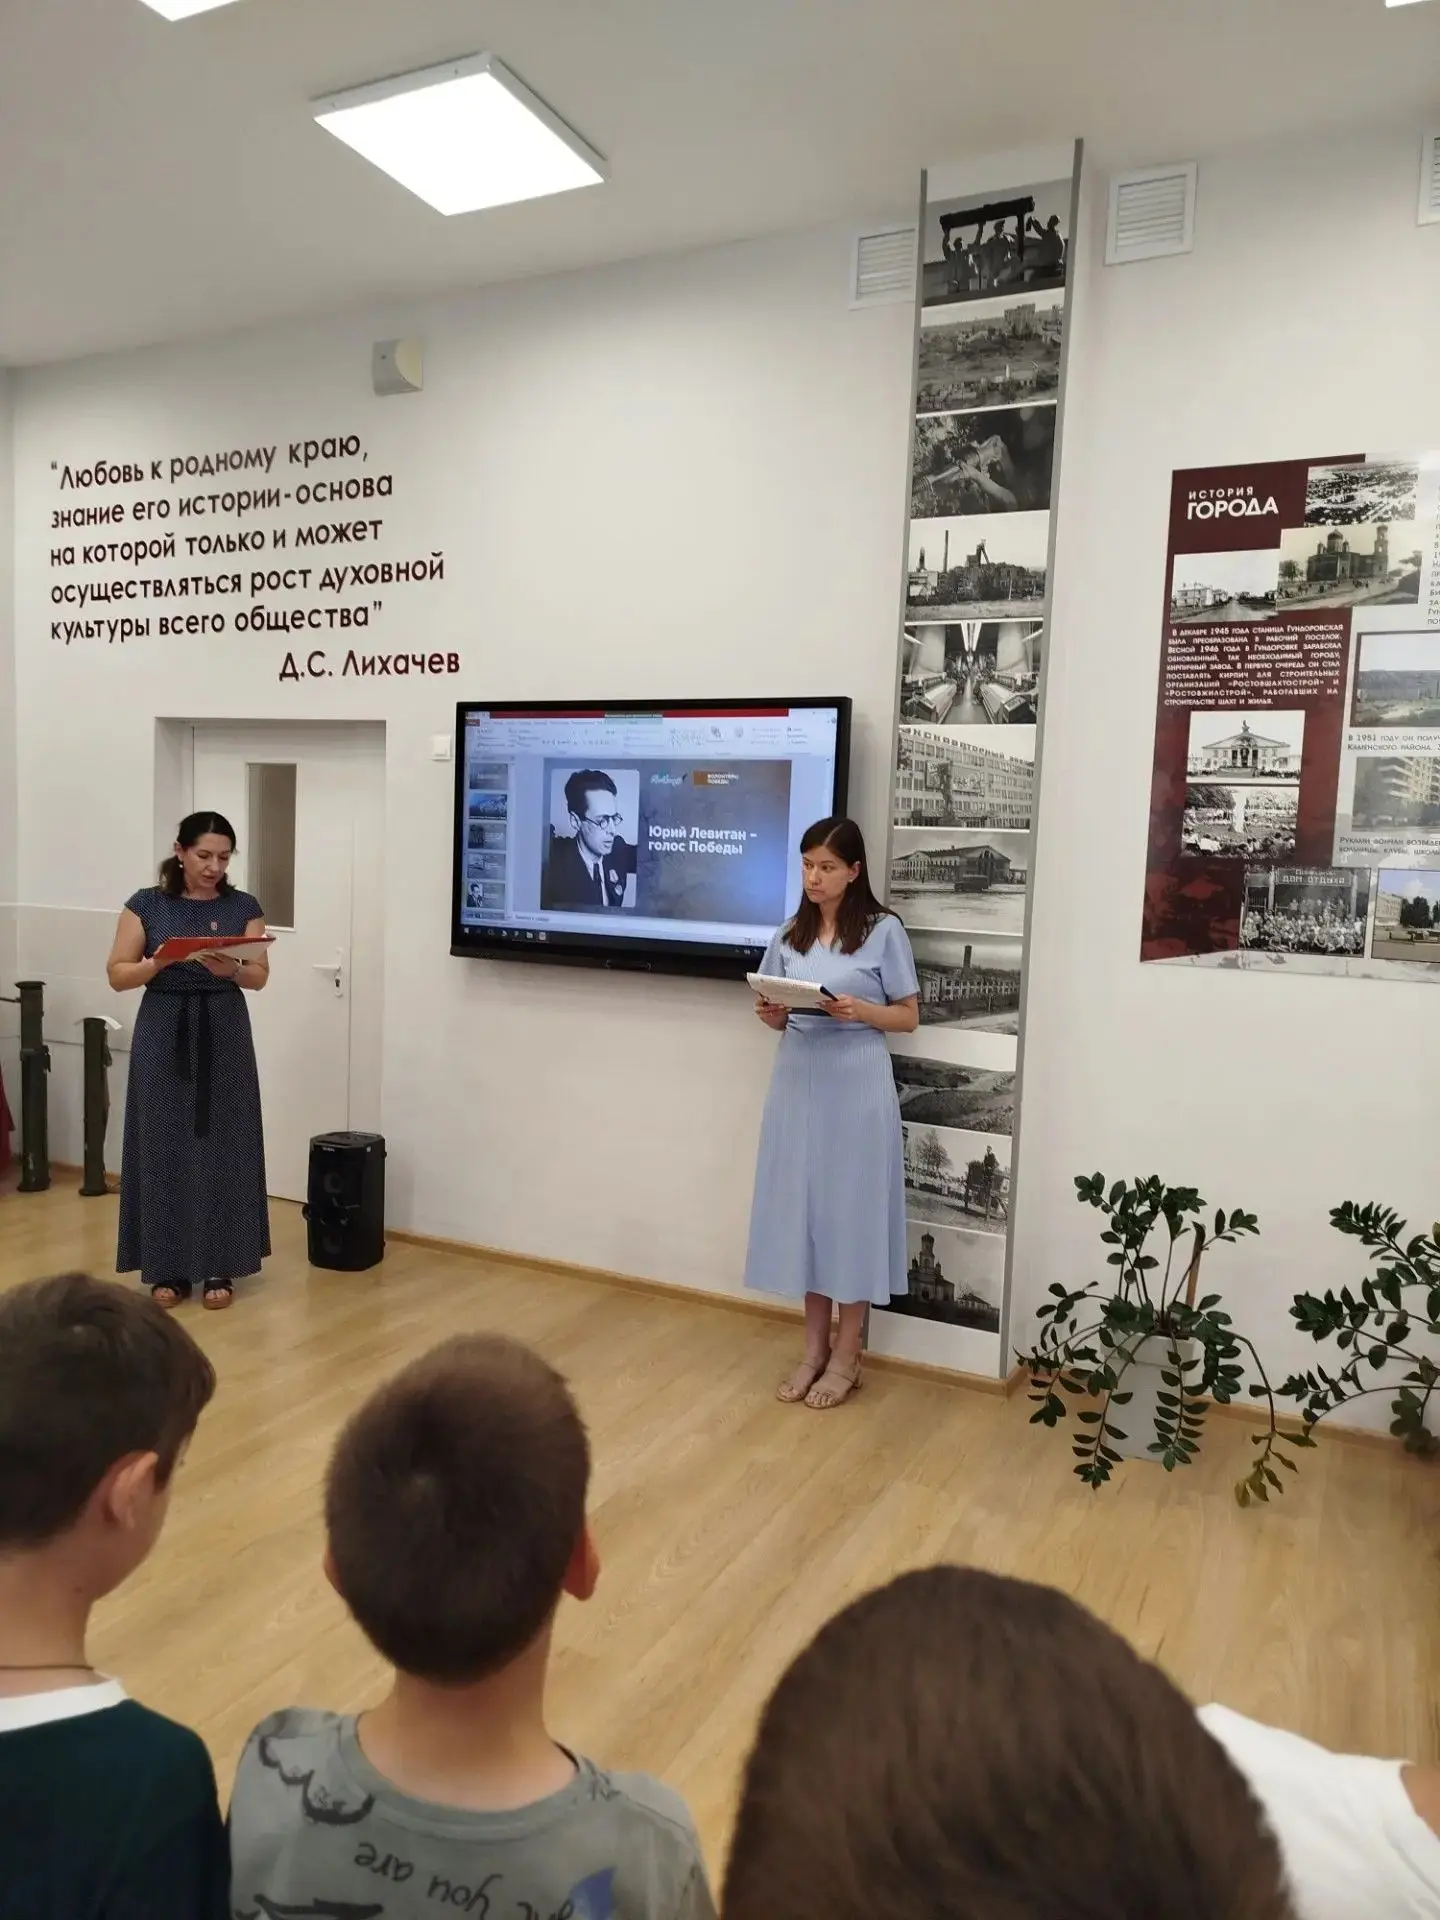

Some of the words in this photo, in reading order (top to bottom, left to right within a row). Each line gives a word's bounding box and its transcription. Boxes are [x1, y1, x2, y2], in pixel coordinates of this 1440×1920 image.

[151, 460, 163, 480] к
[170, 444, 277, 482] родному
[289, 433, 368, 468] краю,
[1188, 486, 1254, 500] ИСТОРИЯ
[51, 502, 125, 529] знание
[133, 498, 170, 522] его
[1187, 496, 1279, 521] ГОРОДА
[50, 545, 75, 567] на
[83, 532, 175, 565] которой
[185, 528, 265, 556] только
[273, 529, 286, 549] и
[295, 518, 383, 548] может
[51, 573, 242, 608] осуществляться
[250, 567, 312, 599] рост
[319, 551, 445, 593] духовной
[51, 616, 150, 645] культуры
[158, 612, 225, 636] всего
[1211, 627, 1229, 635] 1945
[1252, 626, 1284, 634] СТАНИЦА
[1266, 634, 1298, 642] РАБОЧИЙ
[1200, 645, 1219, 653] 1946
[279, 651, 333, 682] Д.С.
[342, 649, 460, 678] Лихачев
[648, 825, 687, 840] Юрий
[689, 826, 747, 841] Левитан
[648, 842, 686, 852] голос
[689, 841, 743, 855] Победы
